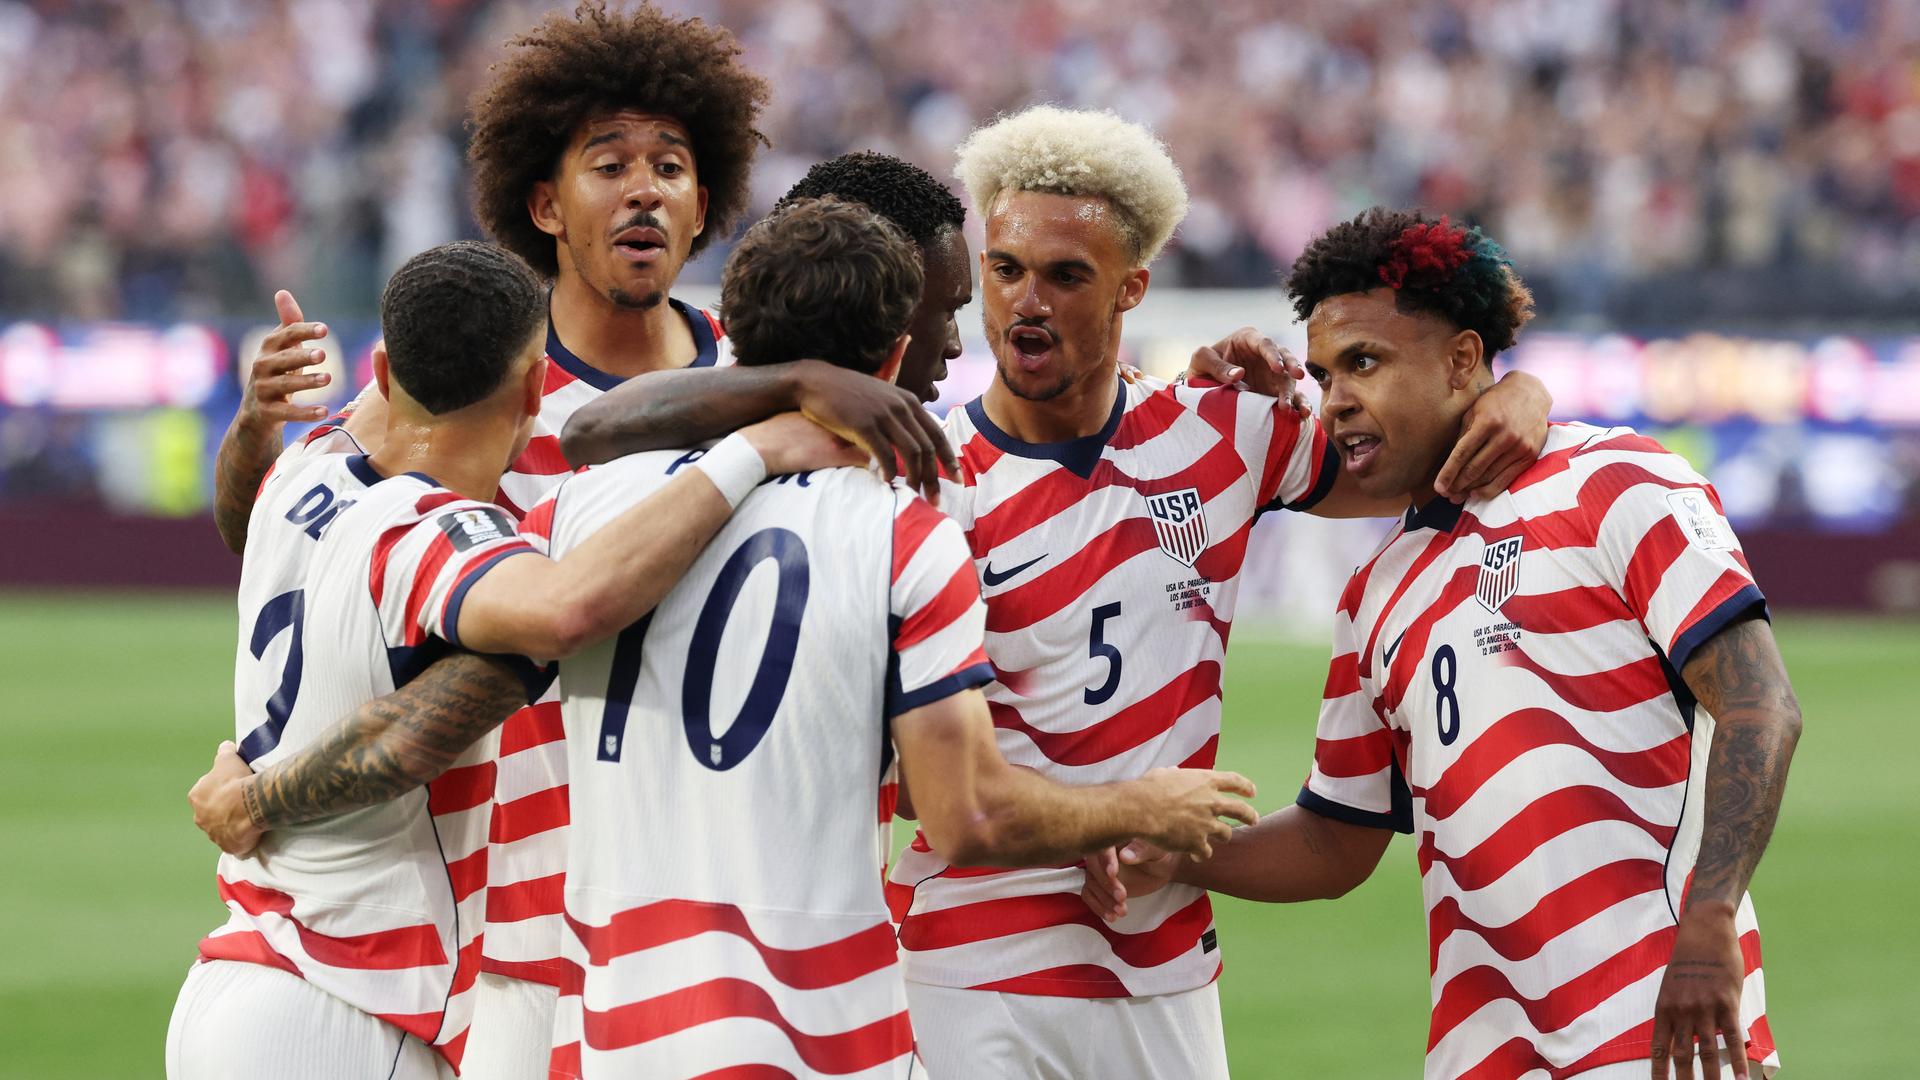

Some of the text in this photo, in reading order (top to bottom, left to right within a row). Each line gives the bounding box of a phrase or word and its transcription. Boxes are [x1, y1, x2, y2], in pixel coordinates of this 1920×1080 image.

[1150, 492, 1199, 523] USA
[1484, 539, 1520, 570] USA
[1166, 582, 1177, 592] USA
[1170, 592, 1179, 602] LOS
[1203, 586, 1210, 595] CA
[1473, 628, 1482, 638] USA
[1477, 637, 1485, 647] LOS
[1513, 631, 1521, 640] CA
[597, 527, 810, 772] 10
[1084, 601, 1122, 705] 5
[1489, 644, 1502, 655] JUNE
[237, 588, 304, 773] 2
[1432, 644, 1460, 746] 8
